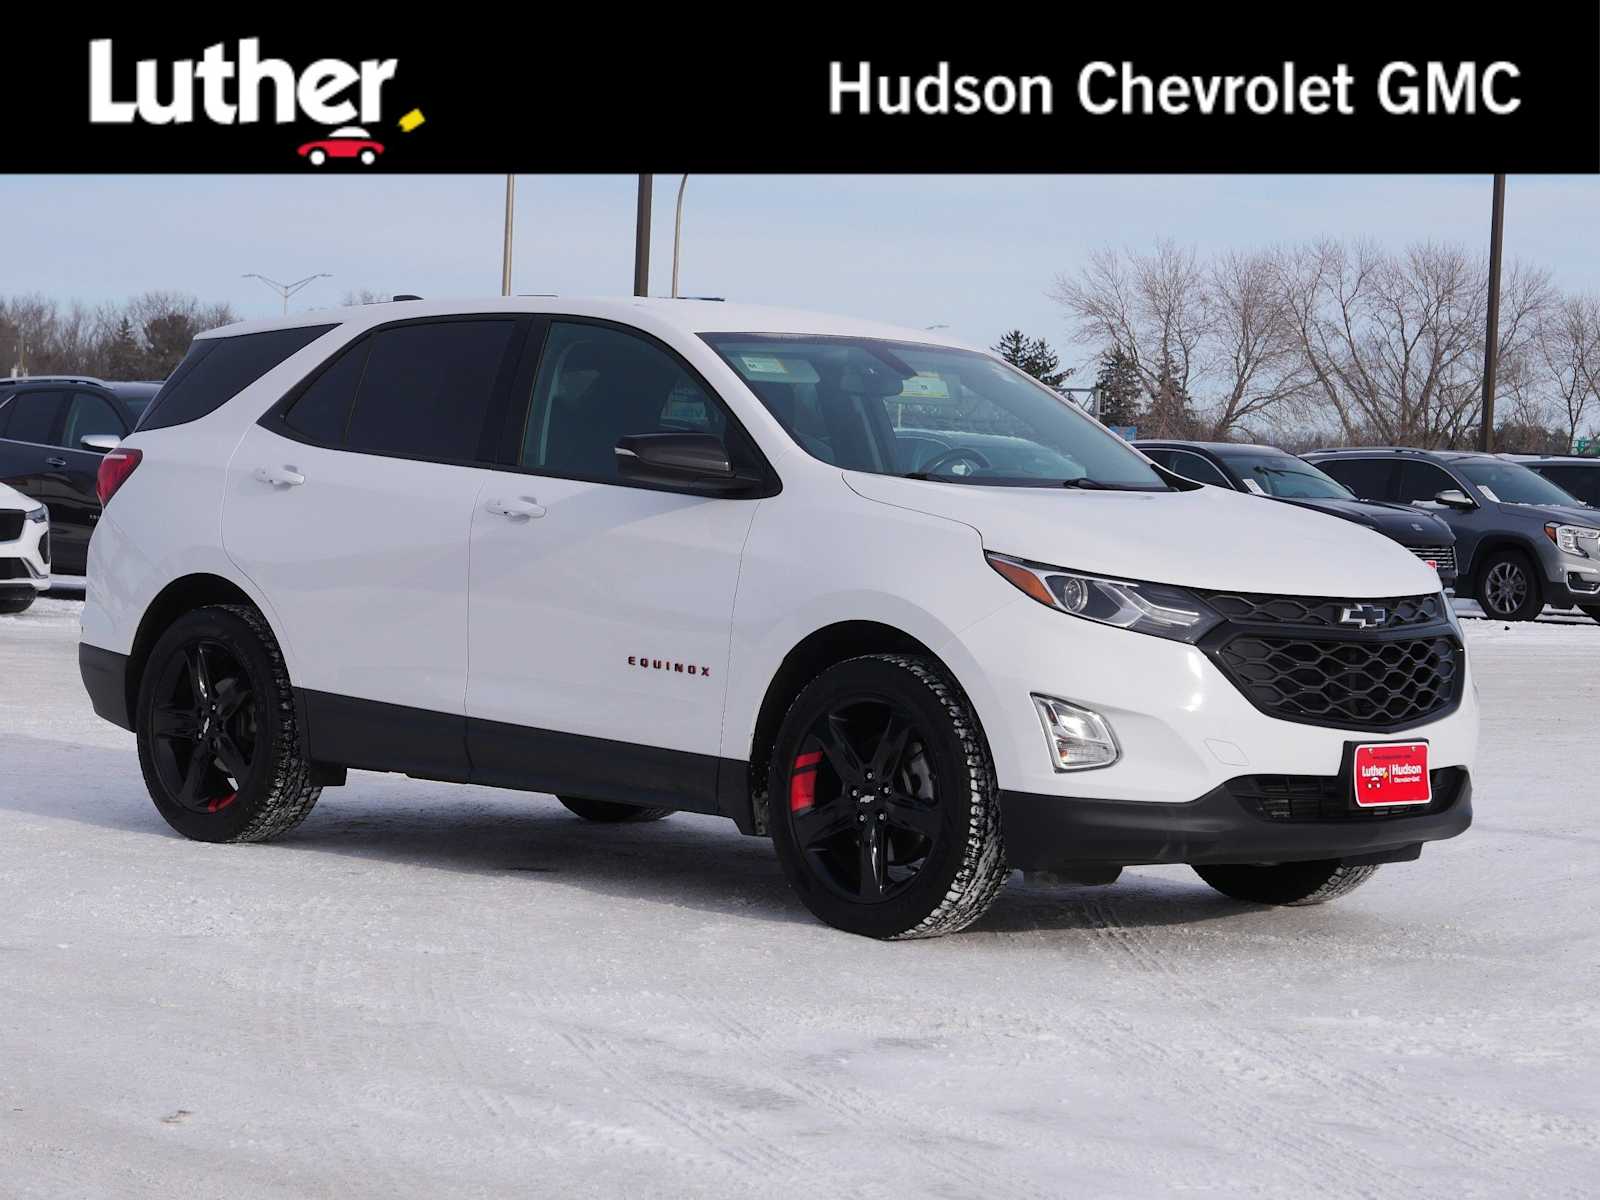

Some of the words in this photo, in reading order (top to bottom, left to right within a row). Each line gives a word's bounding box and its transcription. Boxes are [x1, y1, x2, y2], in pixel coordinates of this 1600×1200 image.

[628, 656, 710, 677] EQUINOX
[1361, 764, 1387, 777] Luther
[1392, 763, 1422, 776] Hudson
